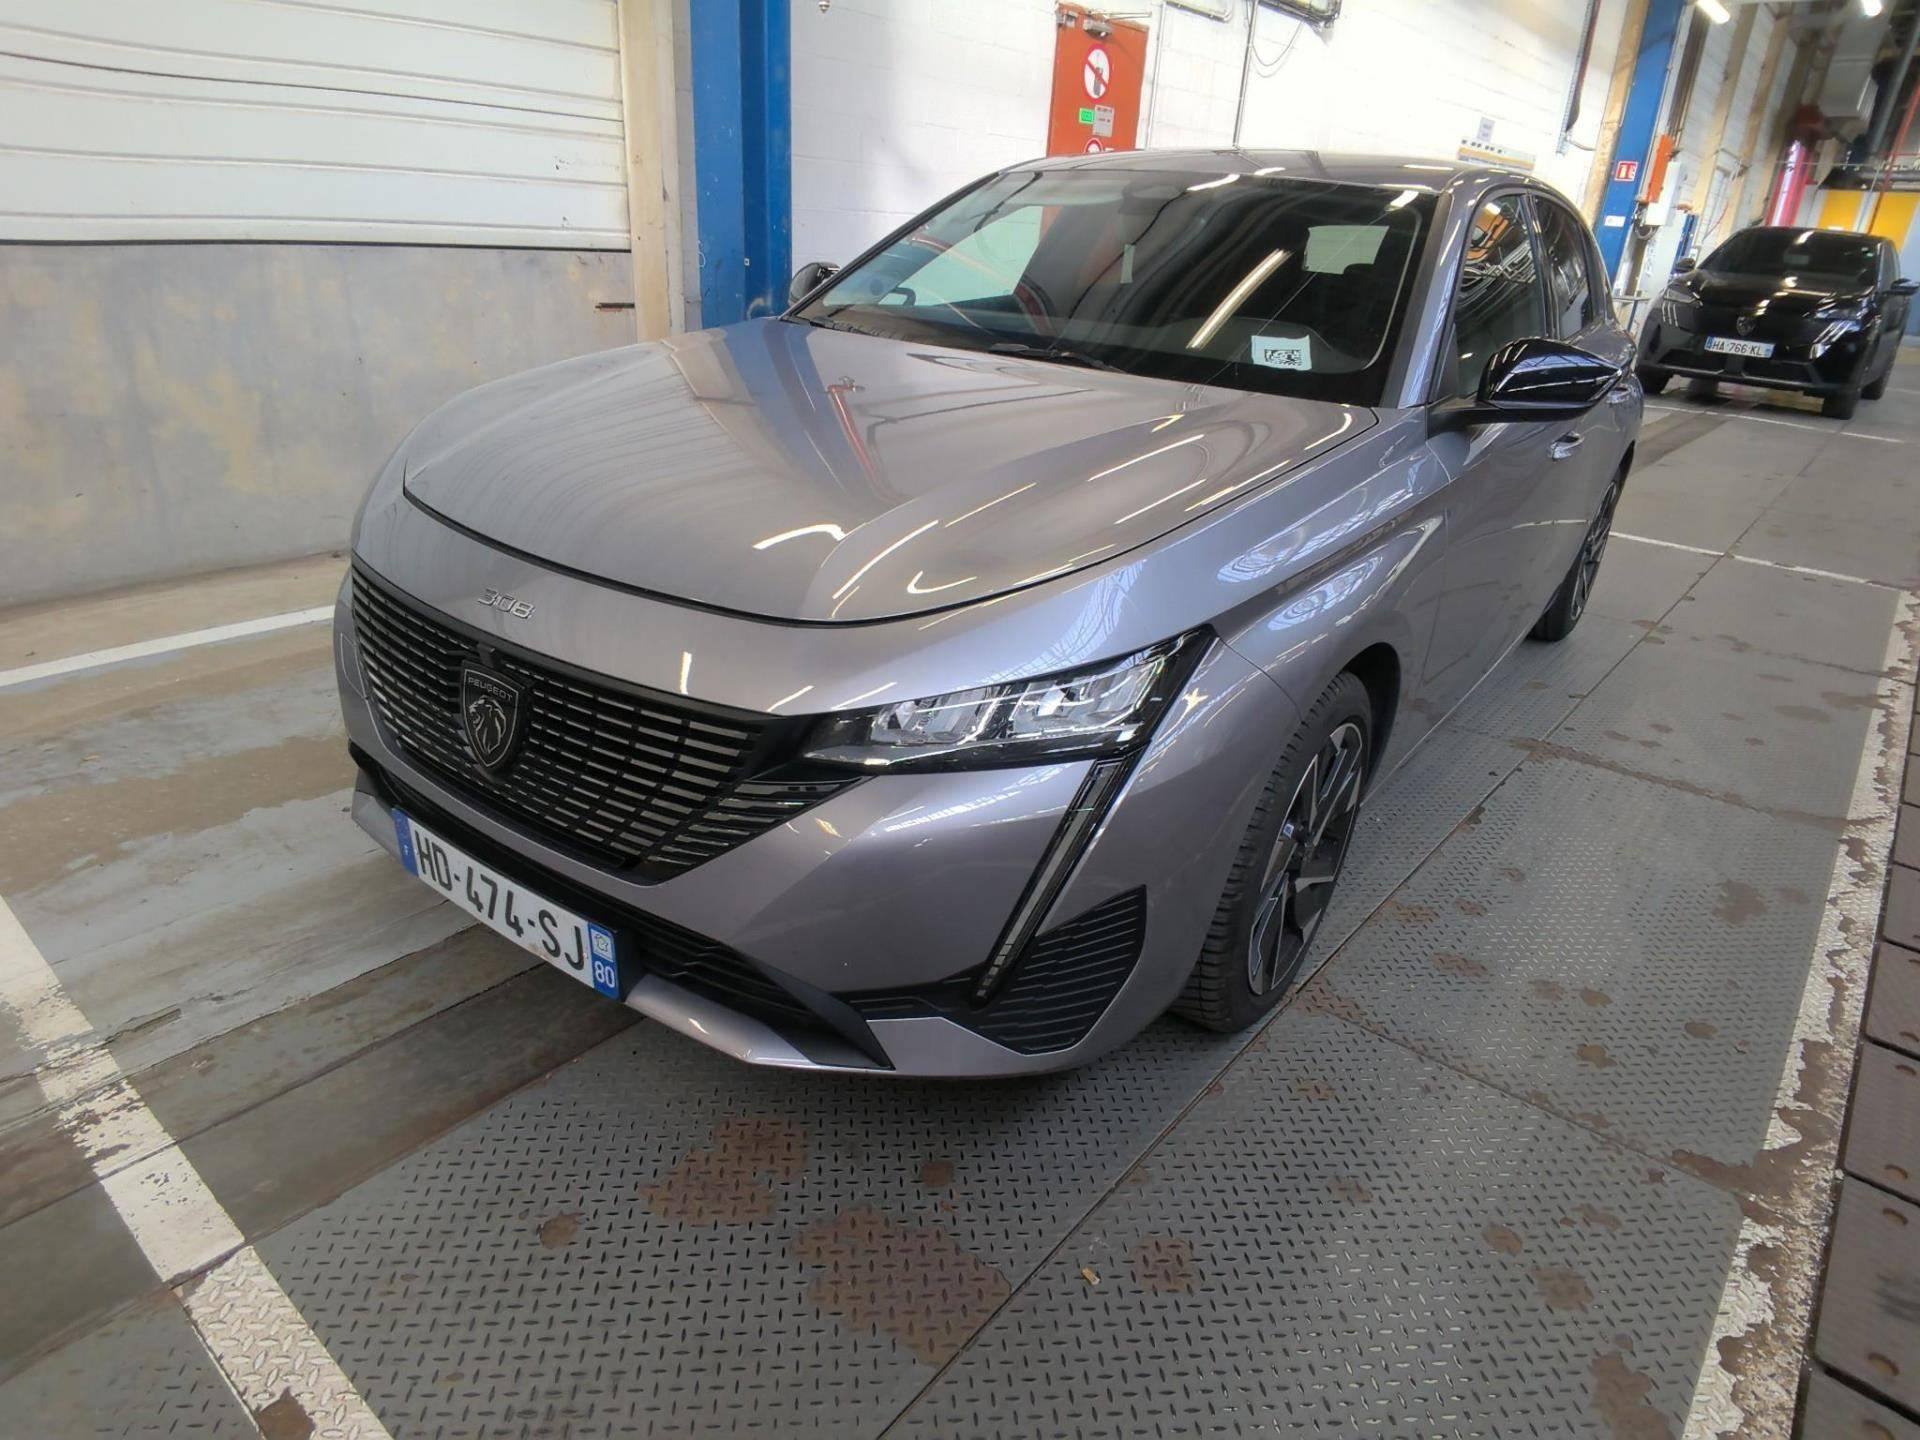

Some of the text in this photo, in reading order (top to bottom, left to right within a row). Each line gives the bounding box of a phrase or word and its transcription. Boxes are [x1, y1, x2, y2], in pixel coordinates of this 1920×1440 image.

[477, 588, 535, 619] 308
[468, 676, 513, 701] PEUGEOT
[414, 829, 585, 971] HD-474-SJ
[594, 960, 616, 989] 80
